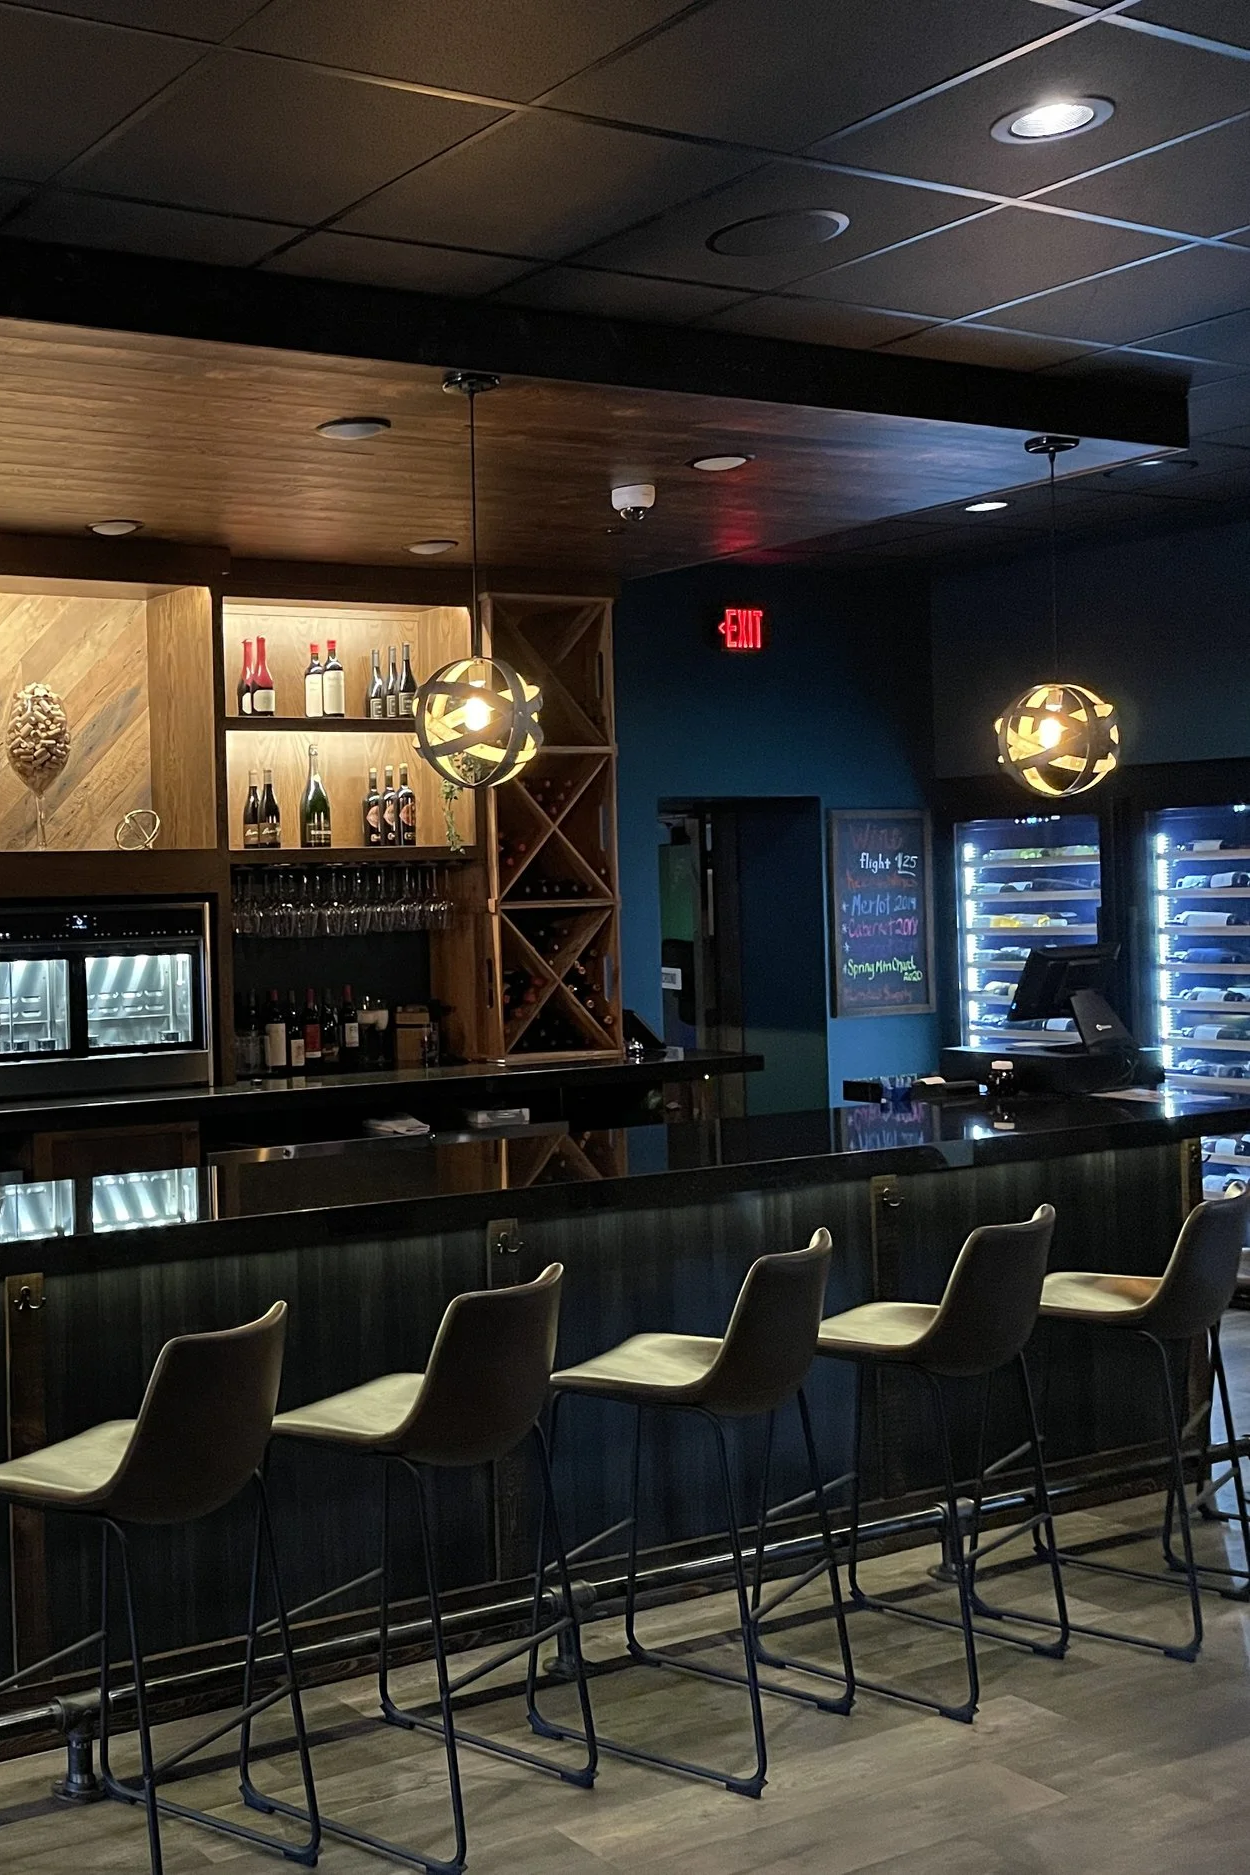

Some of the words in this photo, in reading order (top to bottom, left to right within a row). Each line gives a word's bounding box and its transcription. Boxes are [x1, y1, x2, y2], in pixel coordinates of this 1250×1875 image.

[726, 609, 763, 648] EXIT
[859, 852, 891, 874] flight
[851, 893, 890, 916] Merlot
